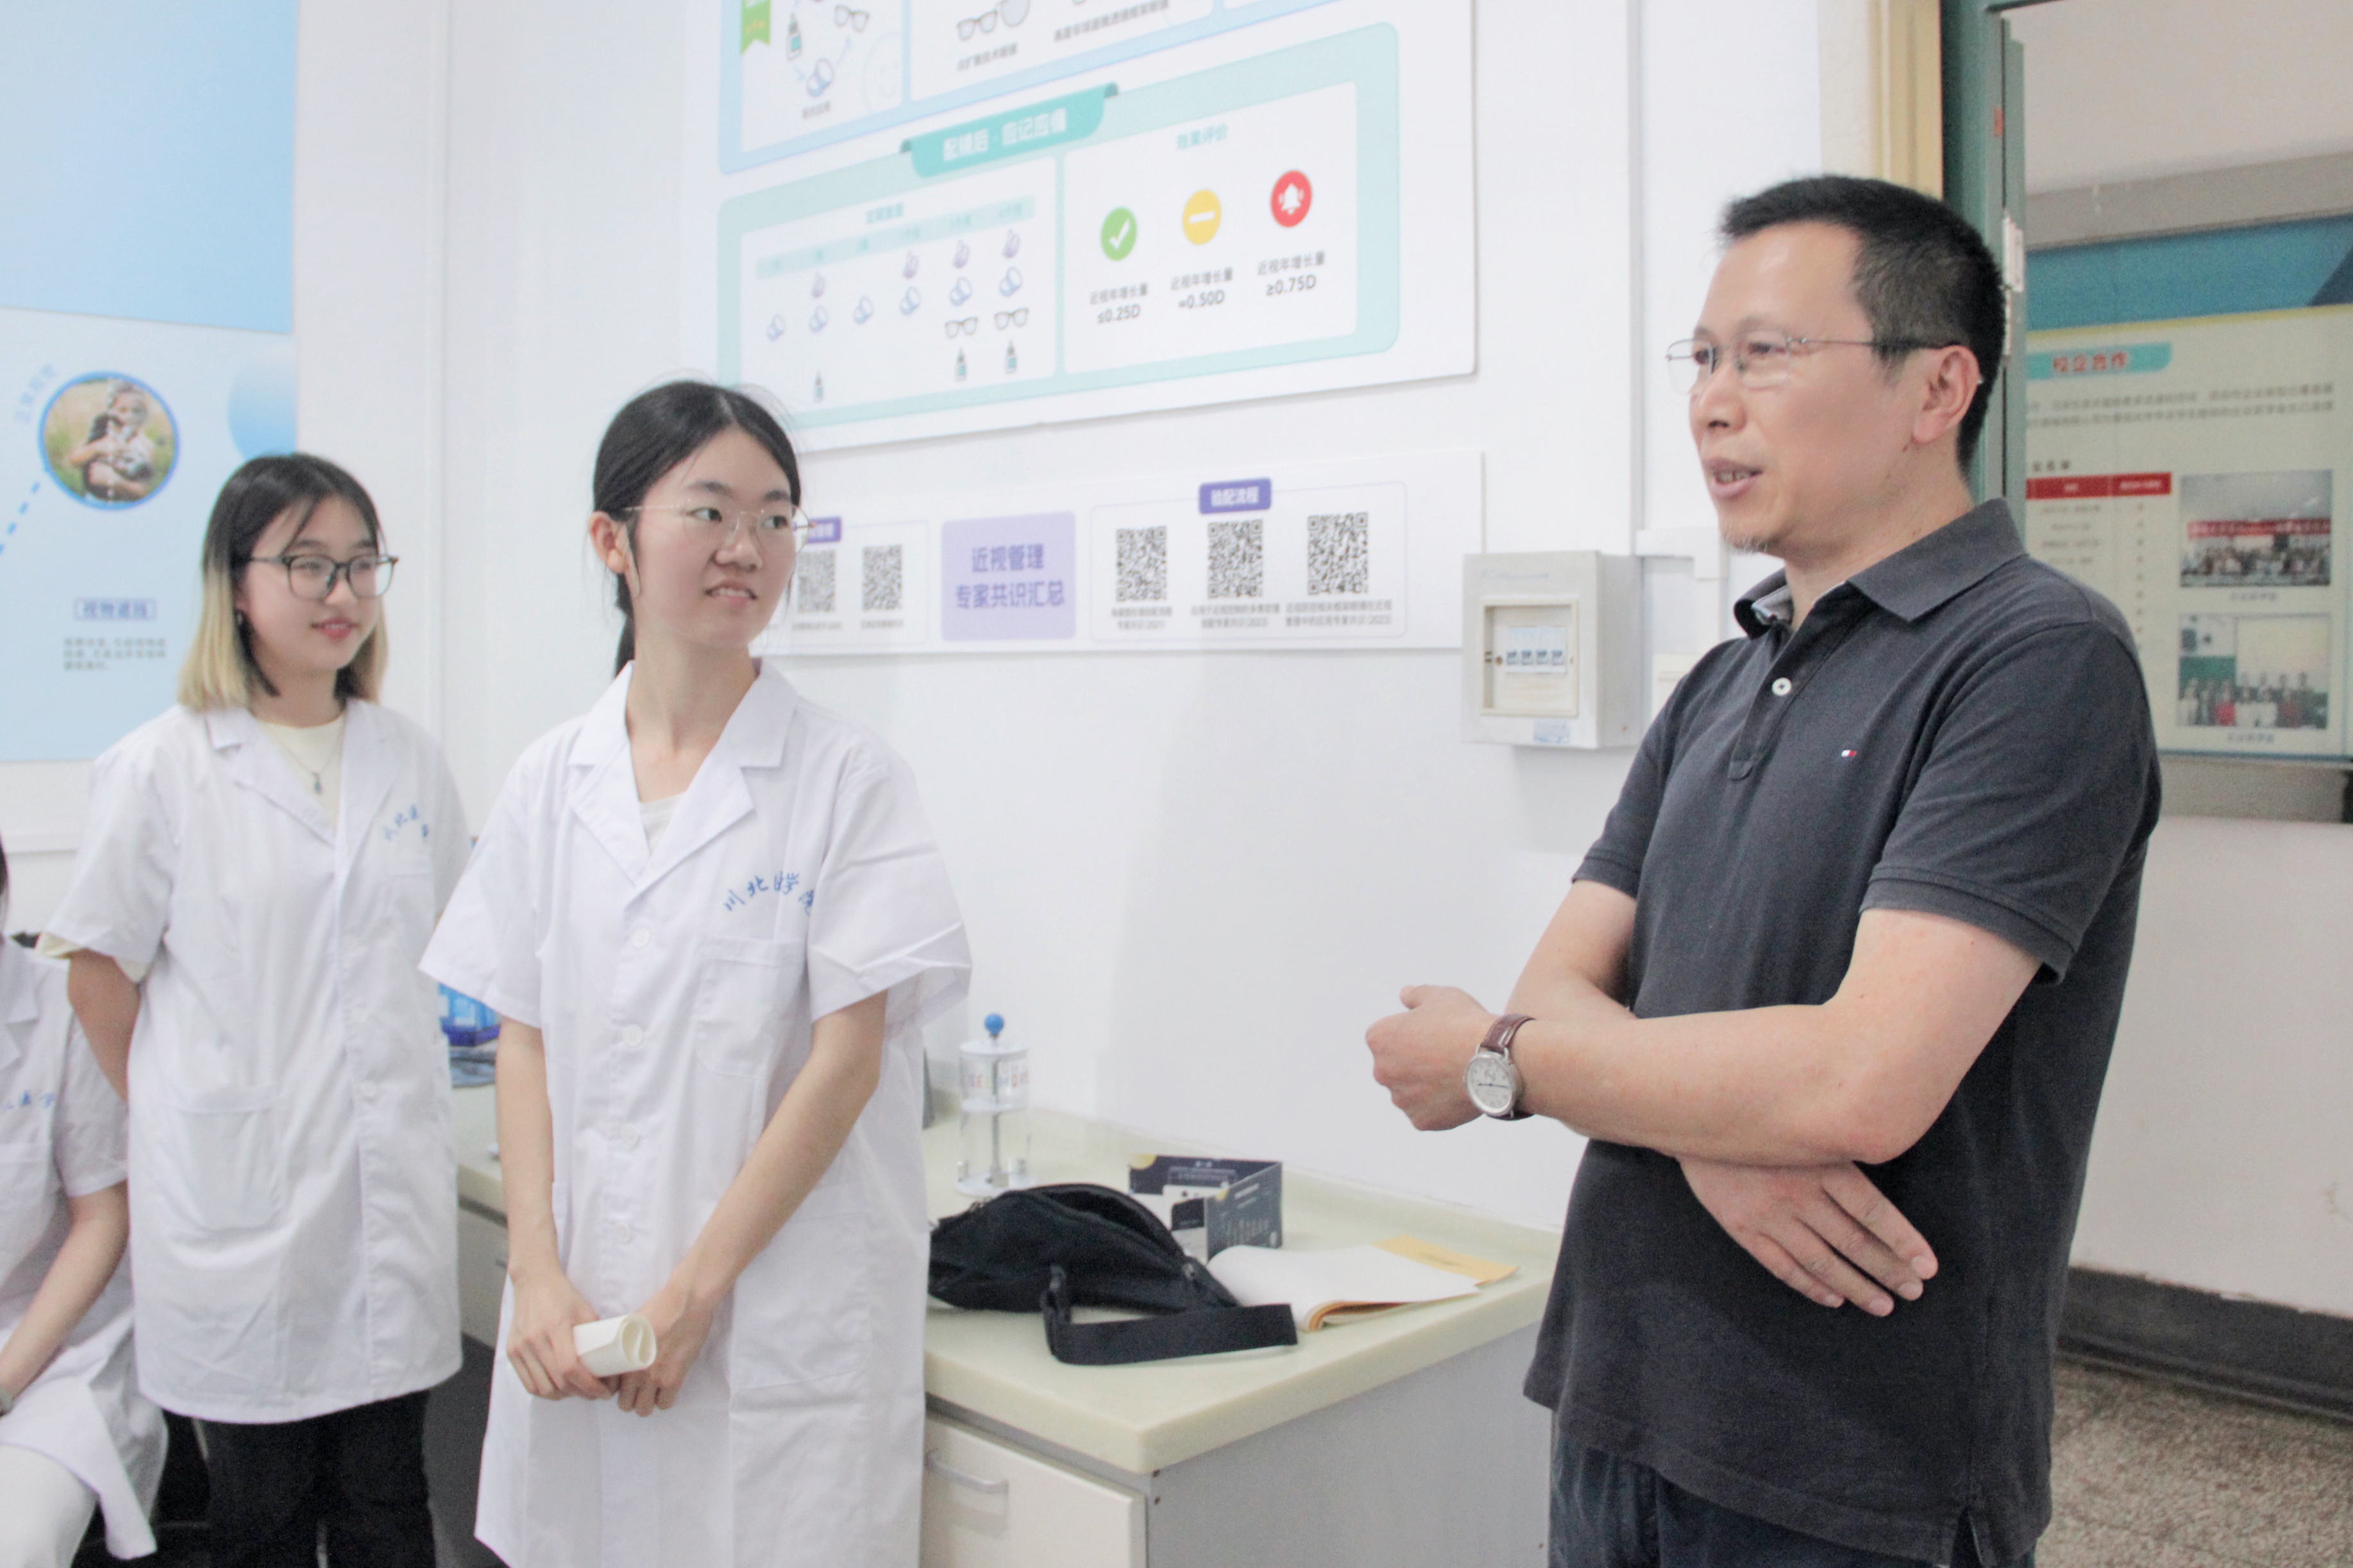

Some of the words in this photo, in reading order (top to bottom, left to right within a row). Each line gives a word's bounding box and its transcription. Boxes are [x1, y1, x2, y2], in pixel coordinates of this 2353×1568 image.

[1257, 251, 1326, 276] 近视年增长量
[1170, 267, 1233, 291] 近视年增长量
[1090, 282, 1149, 305] 近视年增长量
[2054, 351, 2127, 372] 校企合作
[972, 543, 1044, 573] 近视管理
[955, 580, 1065, 609] 专家共识汇总
